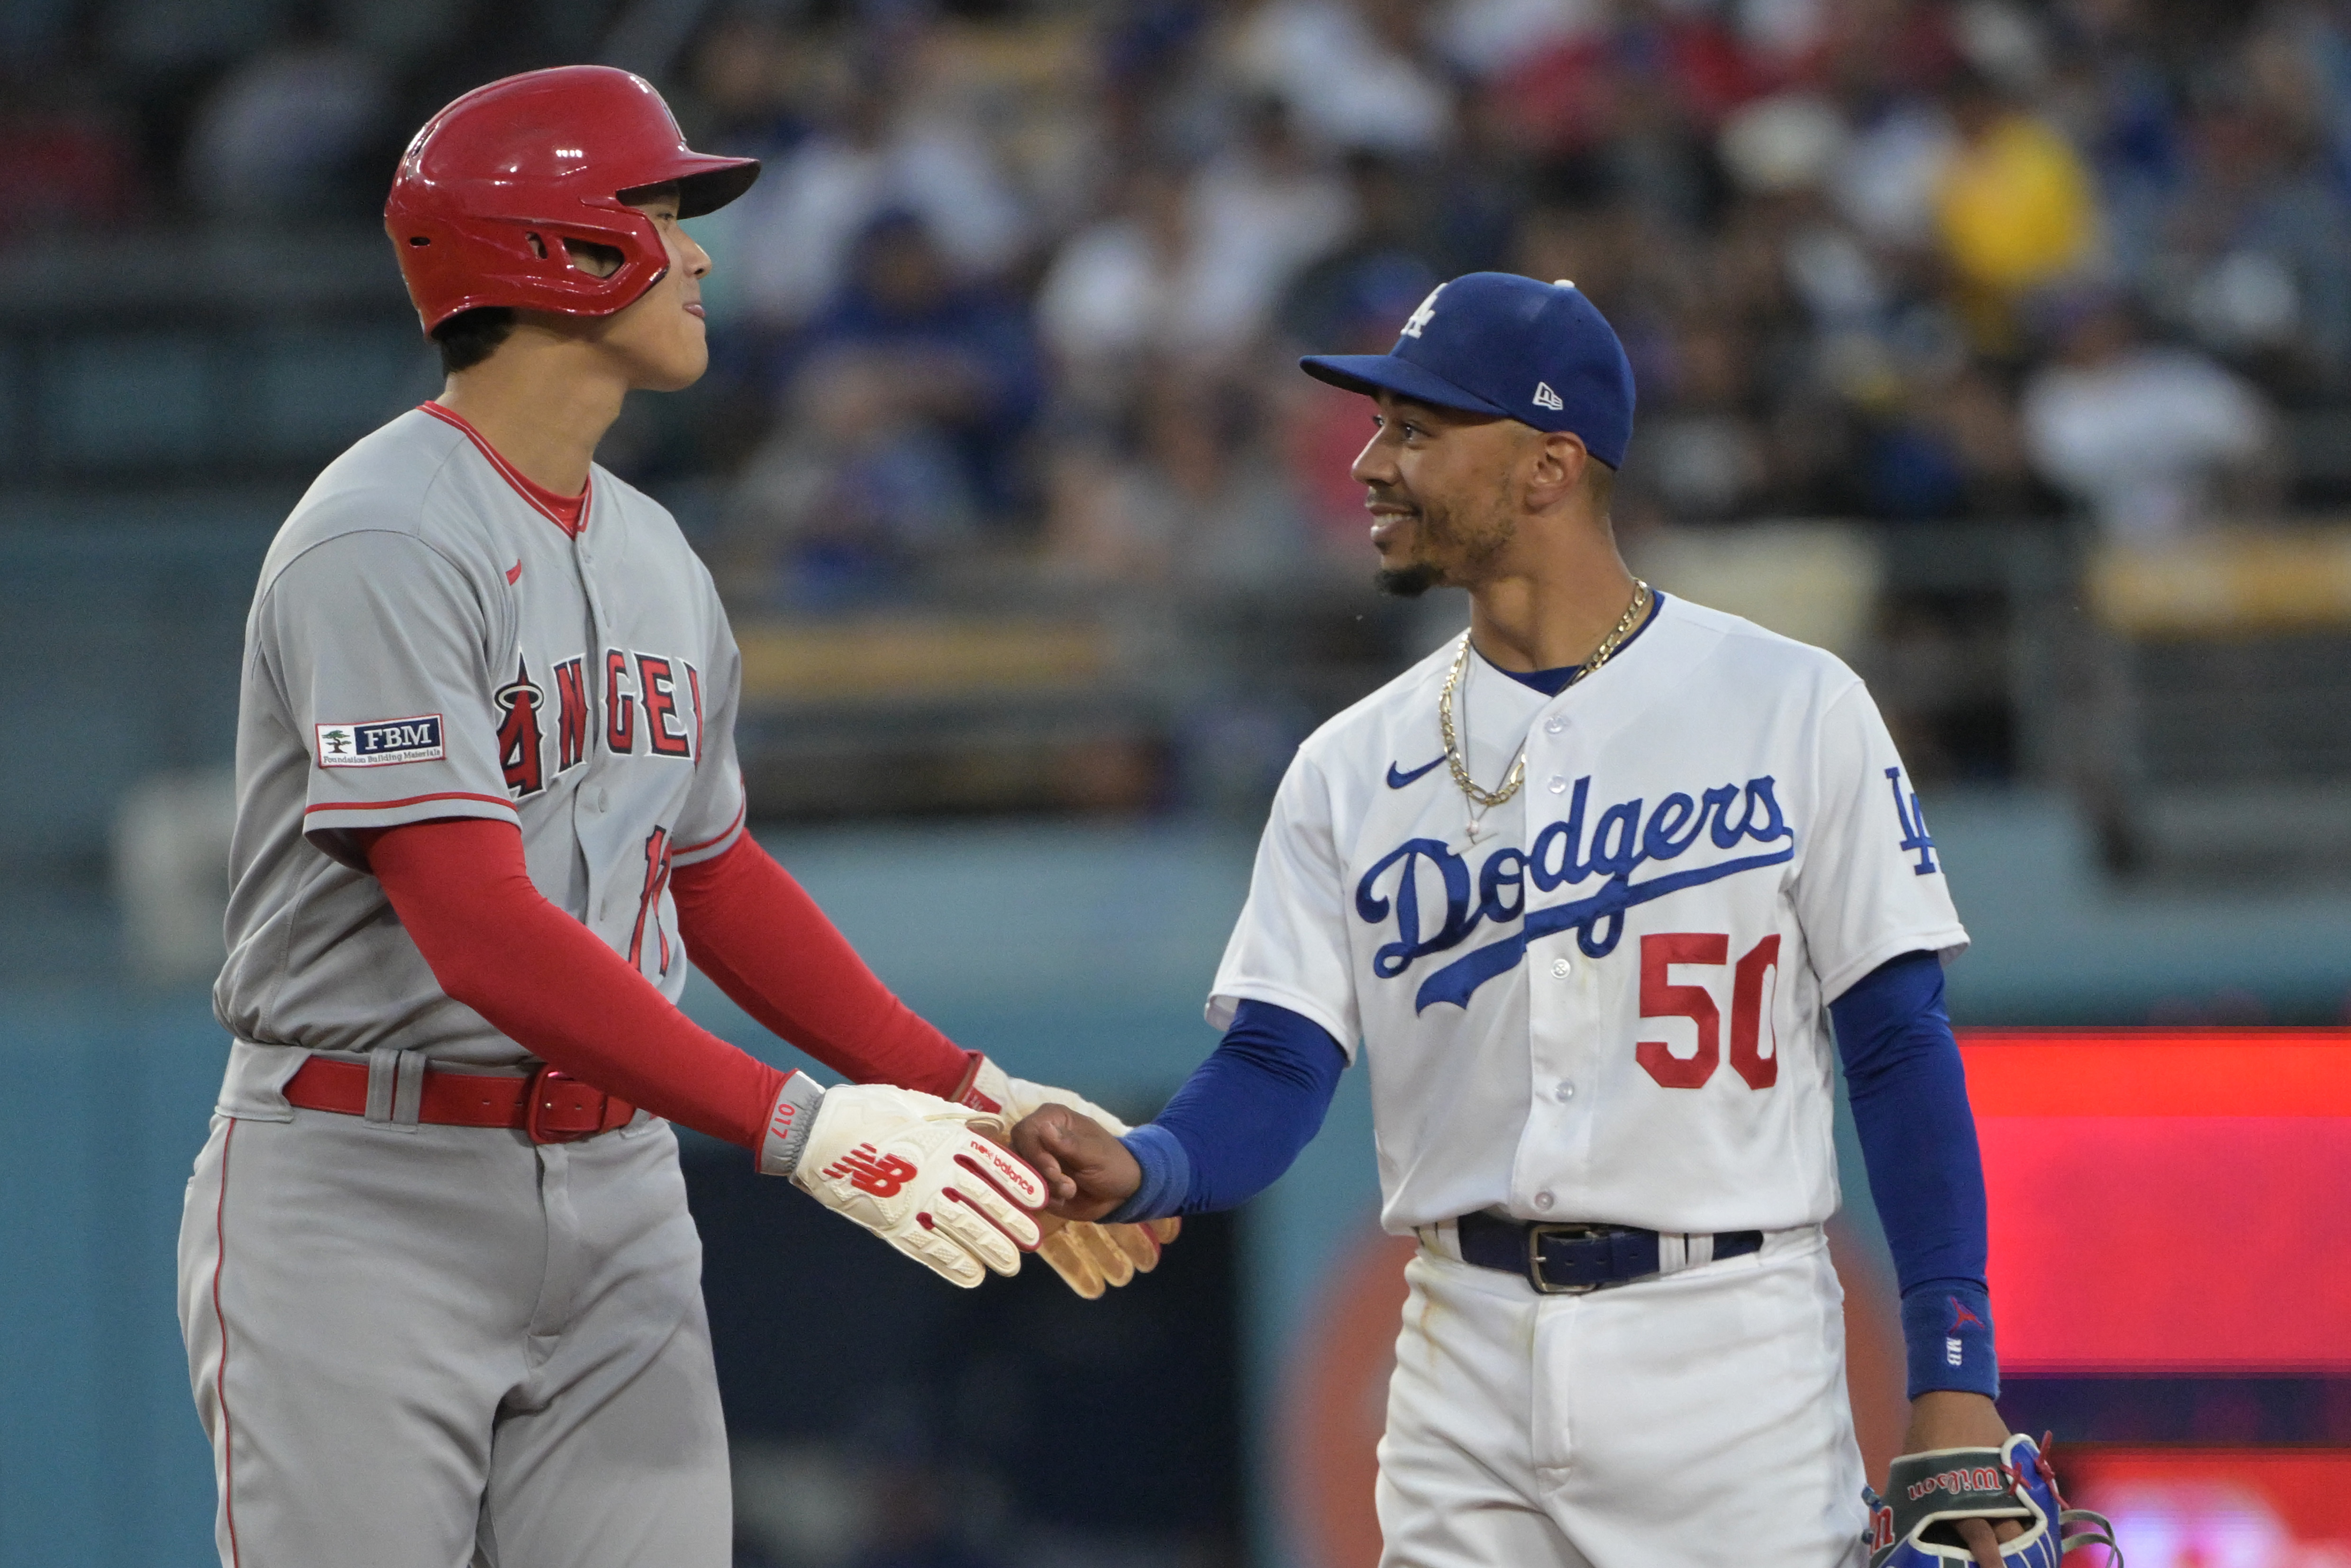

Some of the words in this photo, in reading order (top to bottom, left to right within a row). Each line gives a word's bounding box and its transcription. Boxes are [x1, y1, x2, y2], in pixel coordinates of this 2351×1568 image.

[363, 724, 432, 751] FBM
[323, 755, 366, 763] Foundation
[367, 752, 402, 762] Building
[404, 749, 441, 759] Materials
[1356, 775, 1794, 979] Dodgers
[1636, 933, 1781, 1090] 50
[771, 1103, 796, 1139] 017
[993, 1155, 1034, 1195] balance
[1907, 1467, 2003, 1501] Wilson
